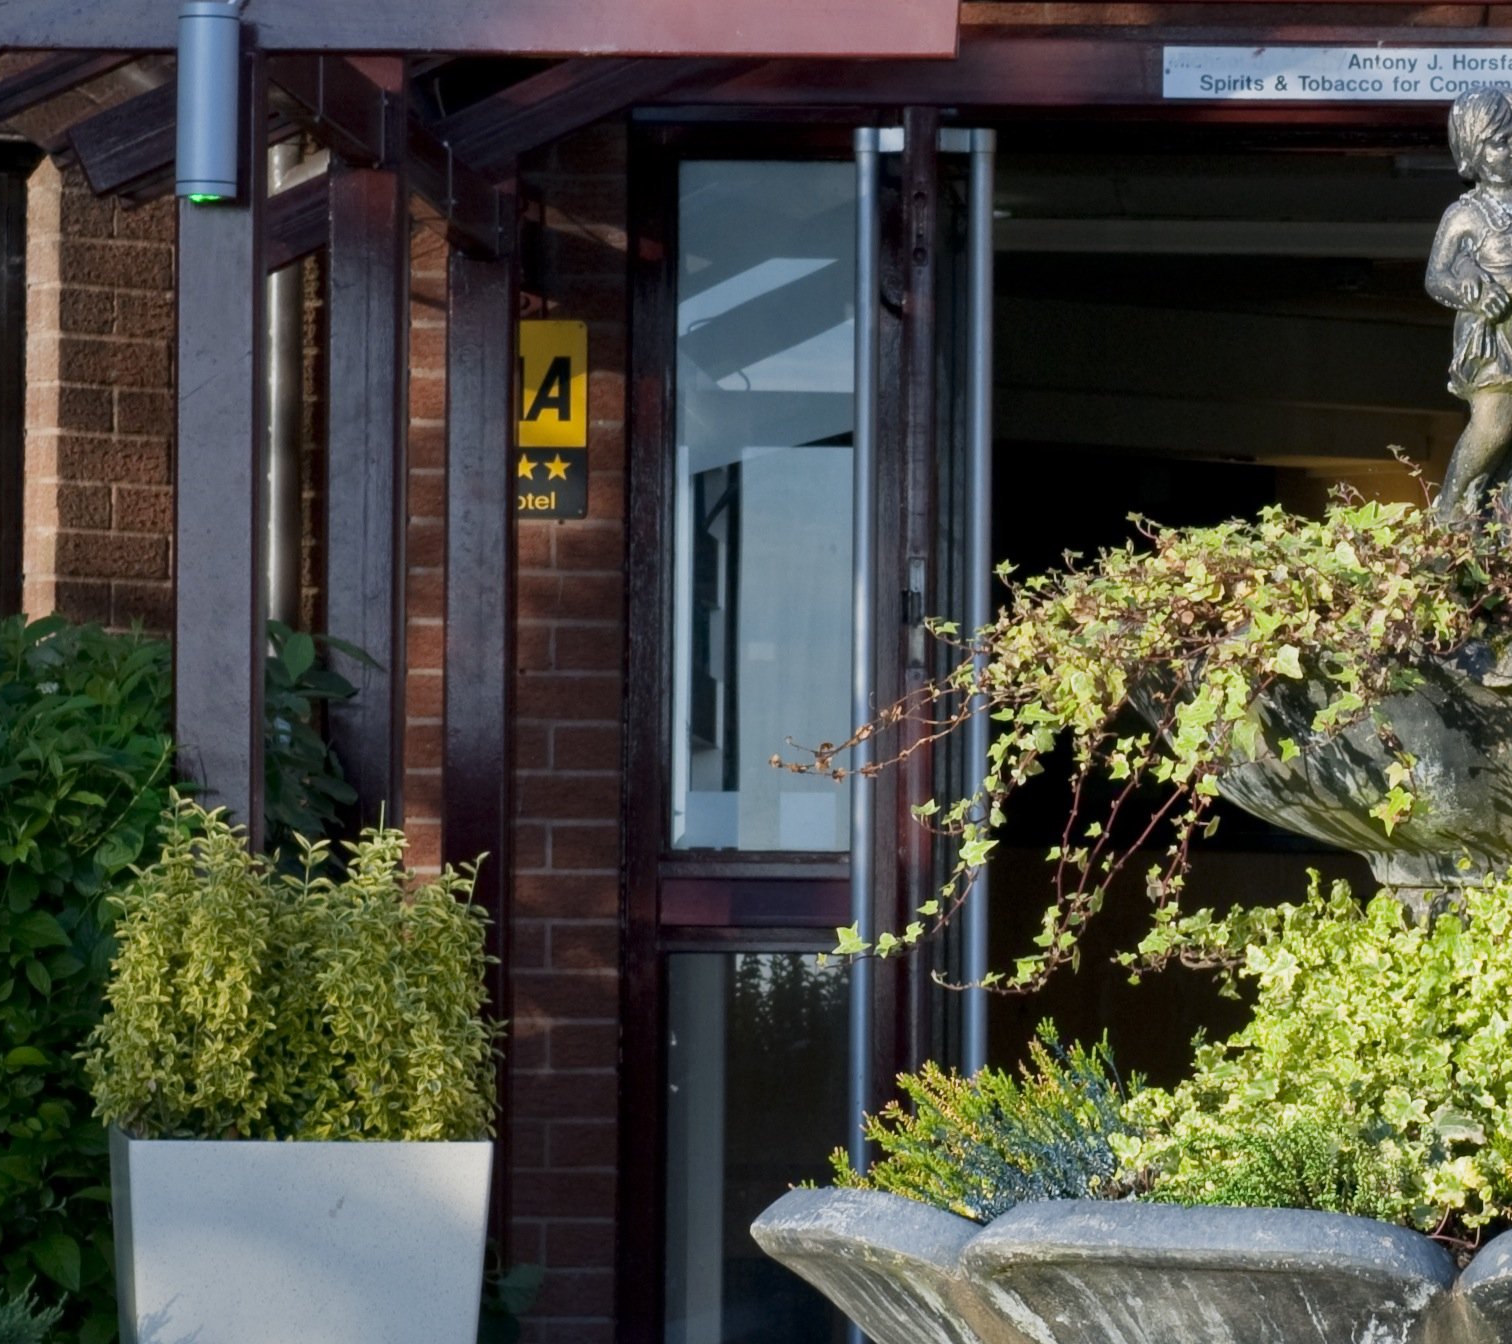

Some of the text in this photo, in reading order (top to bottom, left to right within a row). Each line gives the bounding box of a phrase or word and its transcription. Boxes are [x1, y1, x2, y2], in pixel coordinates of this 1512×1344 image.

[1348, 53, 1418, 73] Antony
[1427, 54, 1443, 70] J.
[1199, 74, 1264, 94] Spirits
[1274, 75, 1288, 92] &
[1297, 75, 1383, 93] Tobacco
[1392, 76, 1421, 93] for
[519, 356, 572, 422] A
[518, 491, 556, 510] otel
